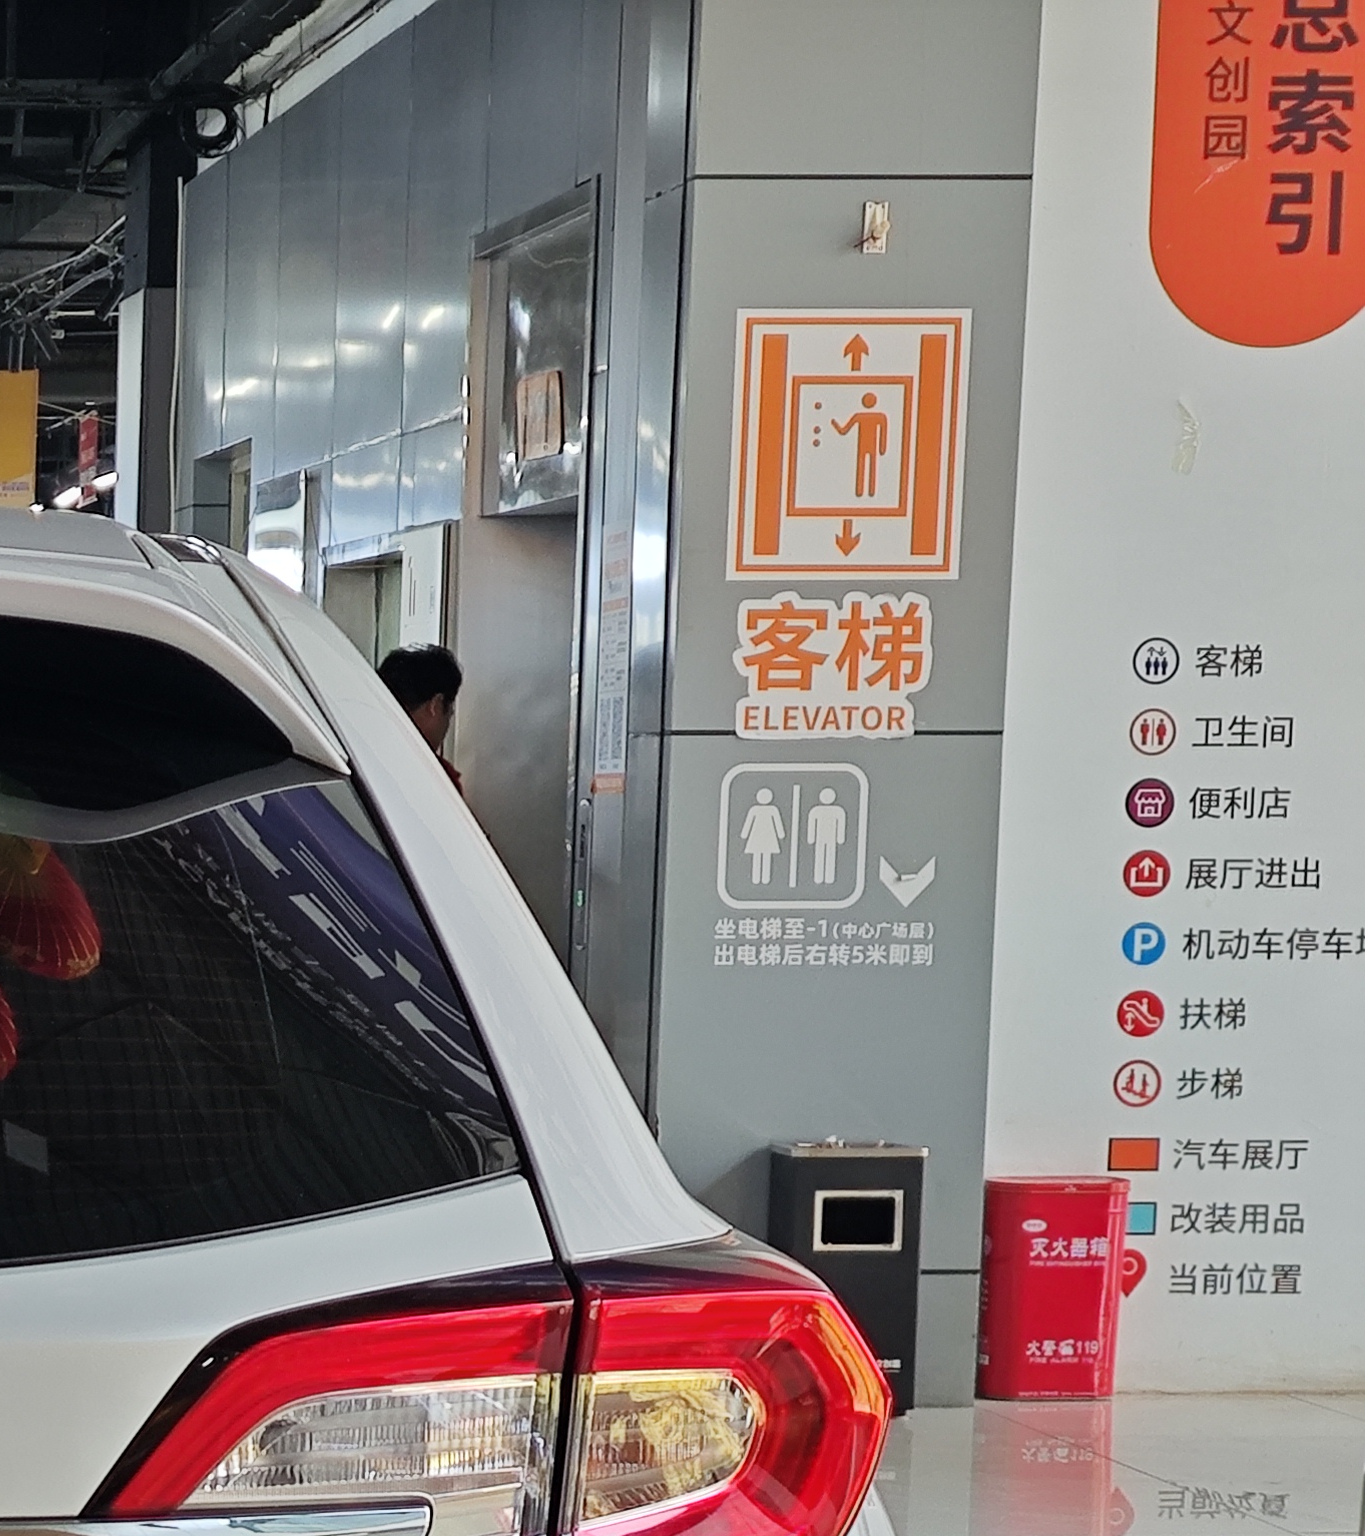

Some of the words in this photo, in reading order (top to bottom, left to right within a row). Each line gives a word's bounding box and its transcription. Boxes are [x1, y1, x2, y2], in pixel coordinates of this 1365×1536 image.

[1203, 0, 1254, 160] 文创园
[741, 600, 925, 693] 客梯
[1194, 644, 1263, 678] 客梯
[743, 704, 907, 732] ELEVATOR
[1191, 716, 1295, 750] 卫生间
[1188, 786, 1292, 821] 便利店
[1184, 857, 1322, 892] 展厅进出
[713, 943, 934, 967] 出电梯后右转5米即到
[1178, 996, 1248, 1031] 扶梯
[1175, 1067, 1245, 1101] 步梯
[1172, 1137, 1310, 1172] 汽车展厅
[1169, 1201, 1305, 1236] 改装用品
[1168, 1262, 1302, 1296] 当前位置
